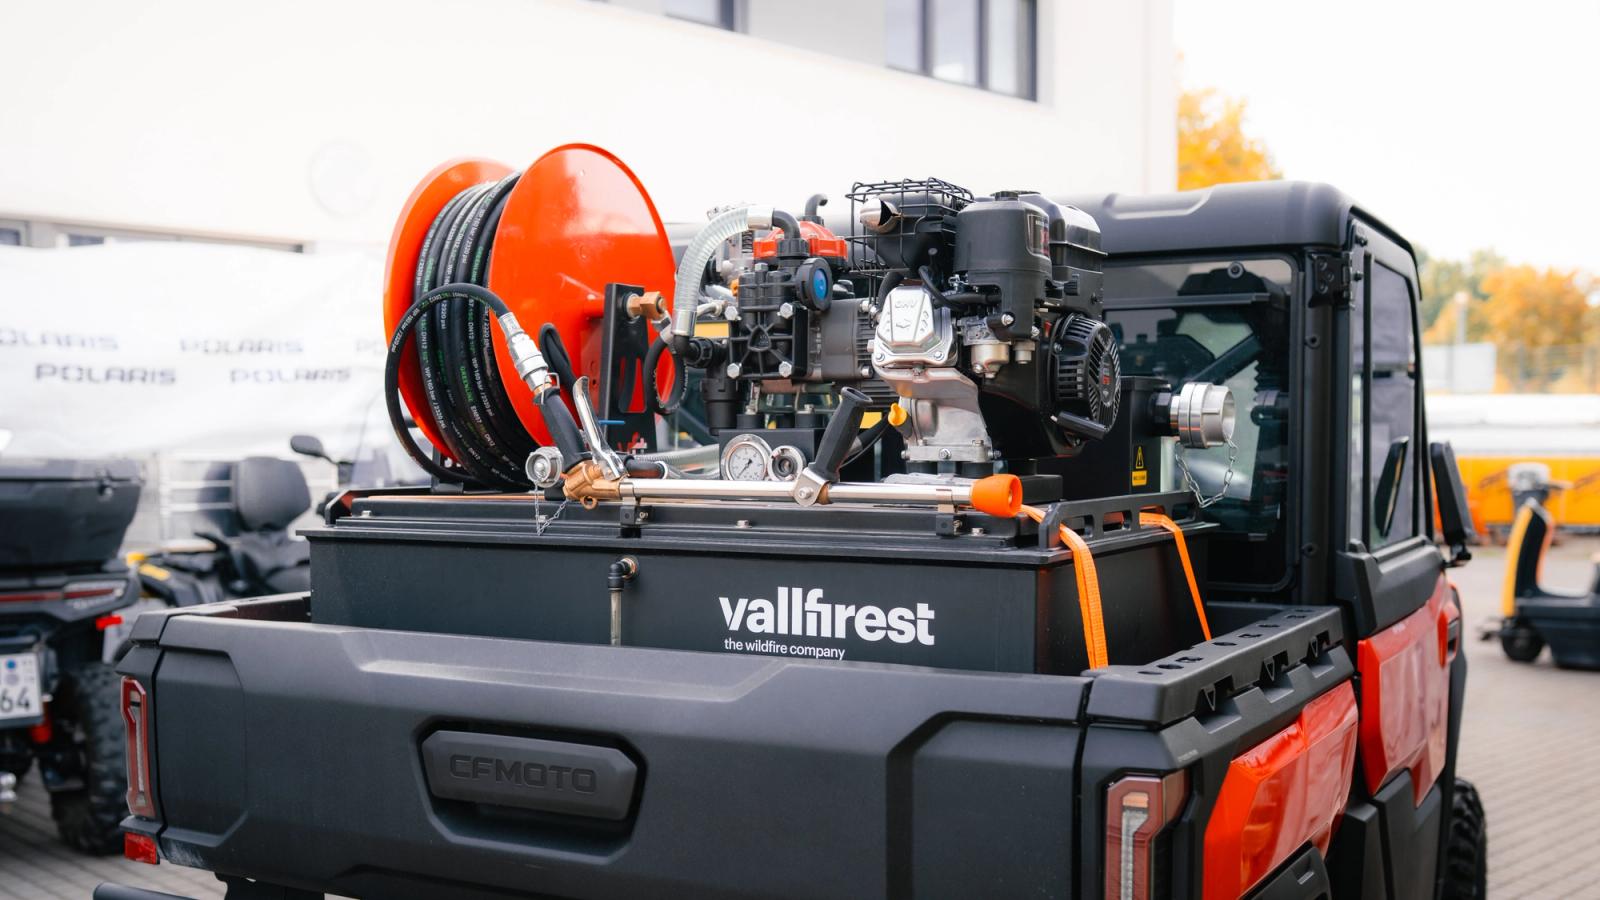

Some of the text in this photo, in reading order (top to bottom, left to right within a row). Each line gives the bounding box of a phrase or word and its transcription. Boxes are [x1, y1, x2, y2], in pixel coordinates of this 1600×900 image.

[35, 363, 177, 384] POLARIS
[424, 366, 431, 378] WP
[718, 586, 935, 646] vallfirest
[724, 637, 846, 661] the wildfire company
[450, 754, 597, 794] CFMOTO
